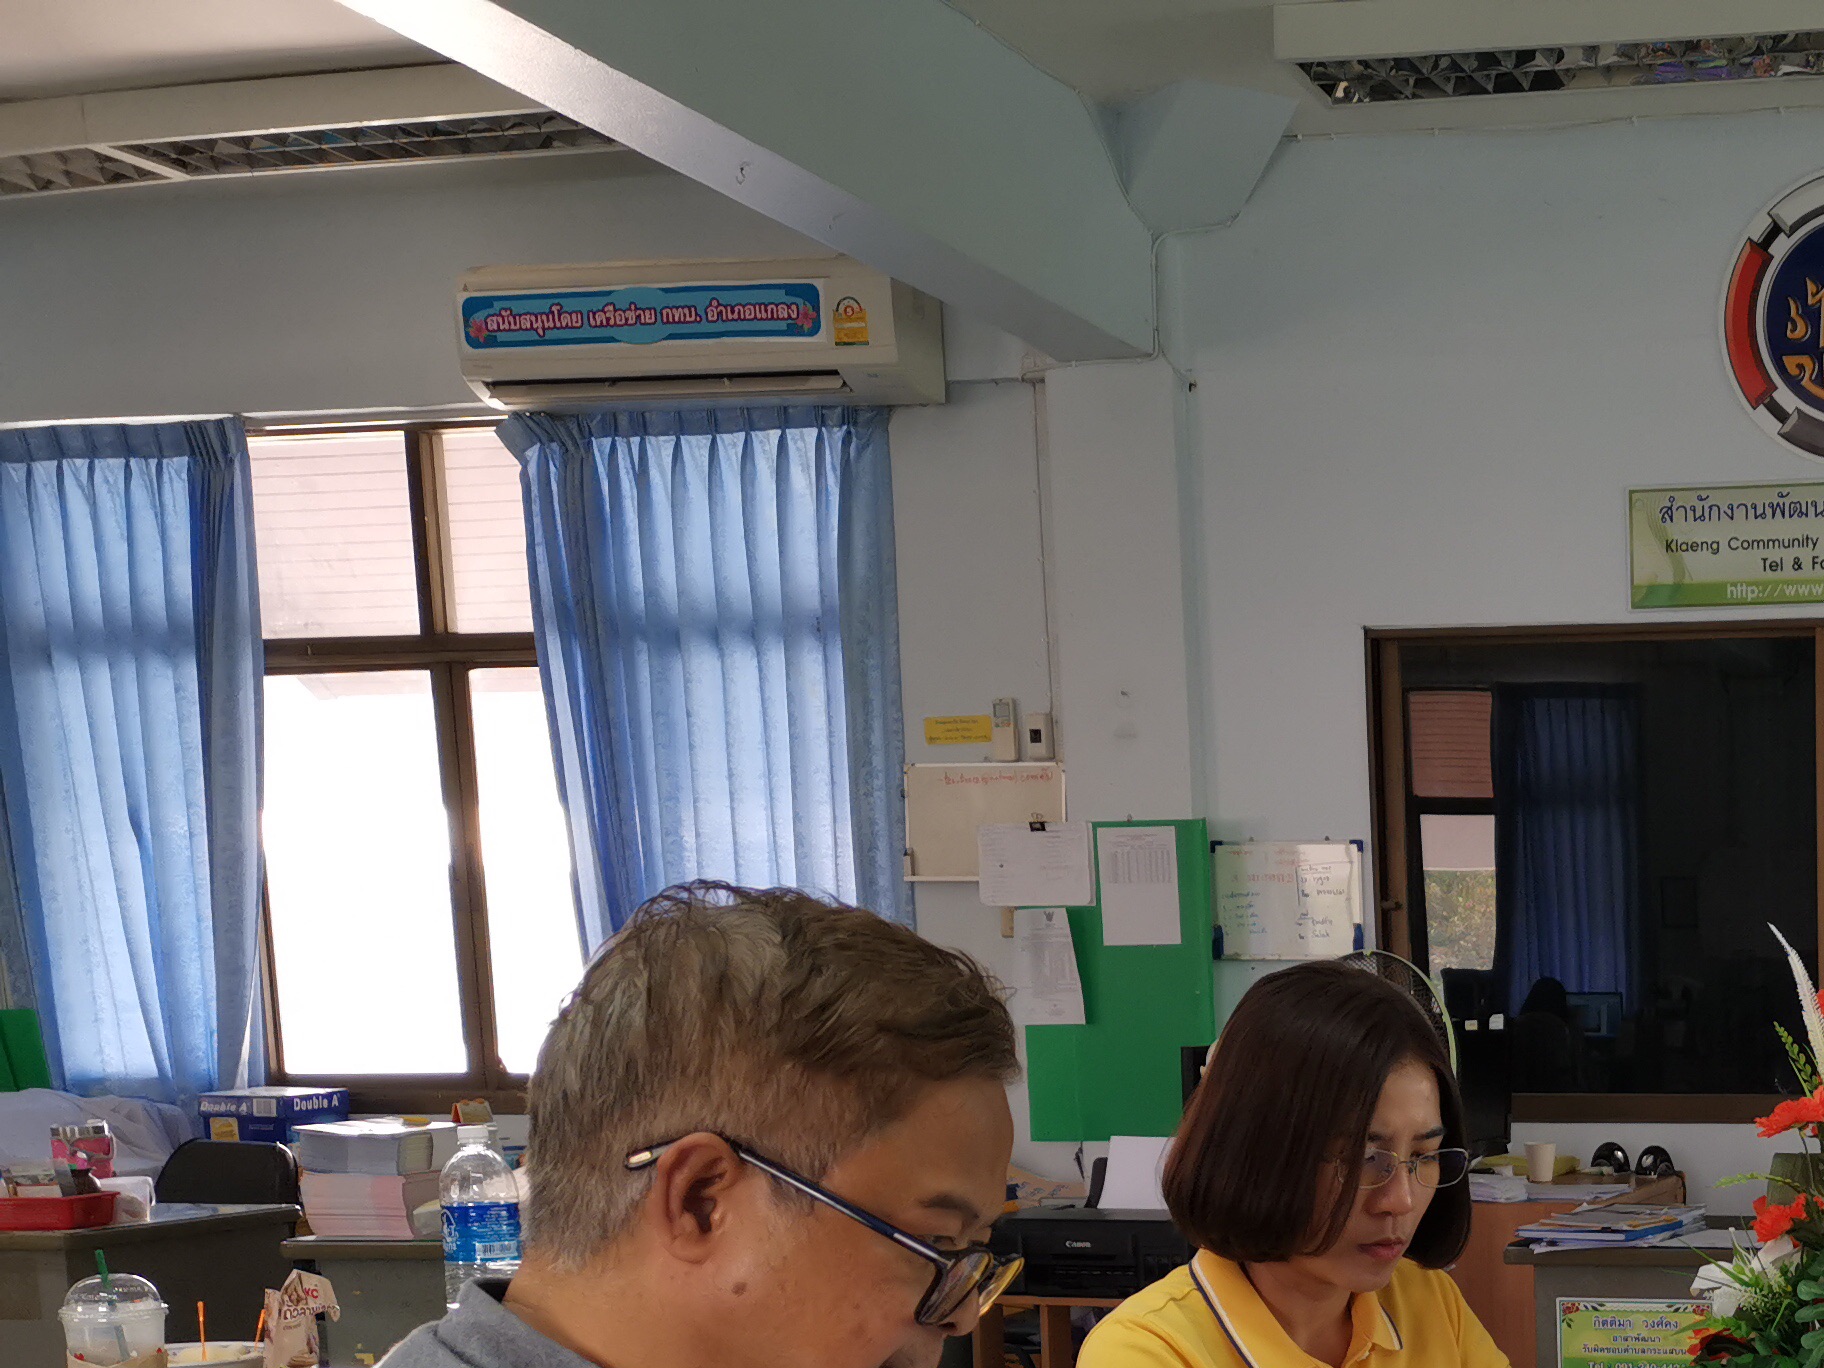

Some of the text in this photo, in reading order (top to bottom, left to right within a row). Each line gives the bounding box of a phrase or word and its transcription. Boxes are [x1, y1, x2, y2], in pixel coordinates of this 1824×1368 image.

[485, 297, 799, 338] สนับสนุนโดย เครือข่าย กทบ. อำเภอแกลง
[1665, 538, 1720, 555] Klaeng
[1727, 533, 1820, 551] Community
[1761, 556, 1784, 572] Tel
[1791, 556, 1803, 571] &
[200, 1100, 248, 1112] Double A
[293, 1094, 339, 1111] Double A
